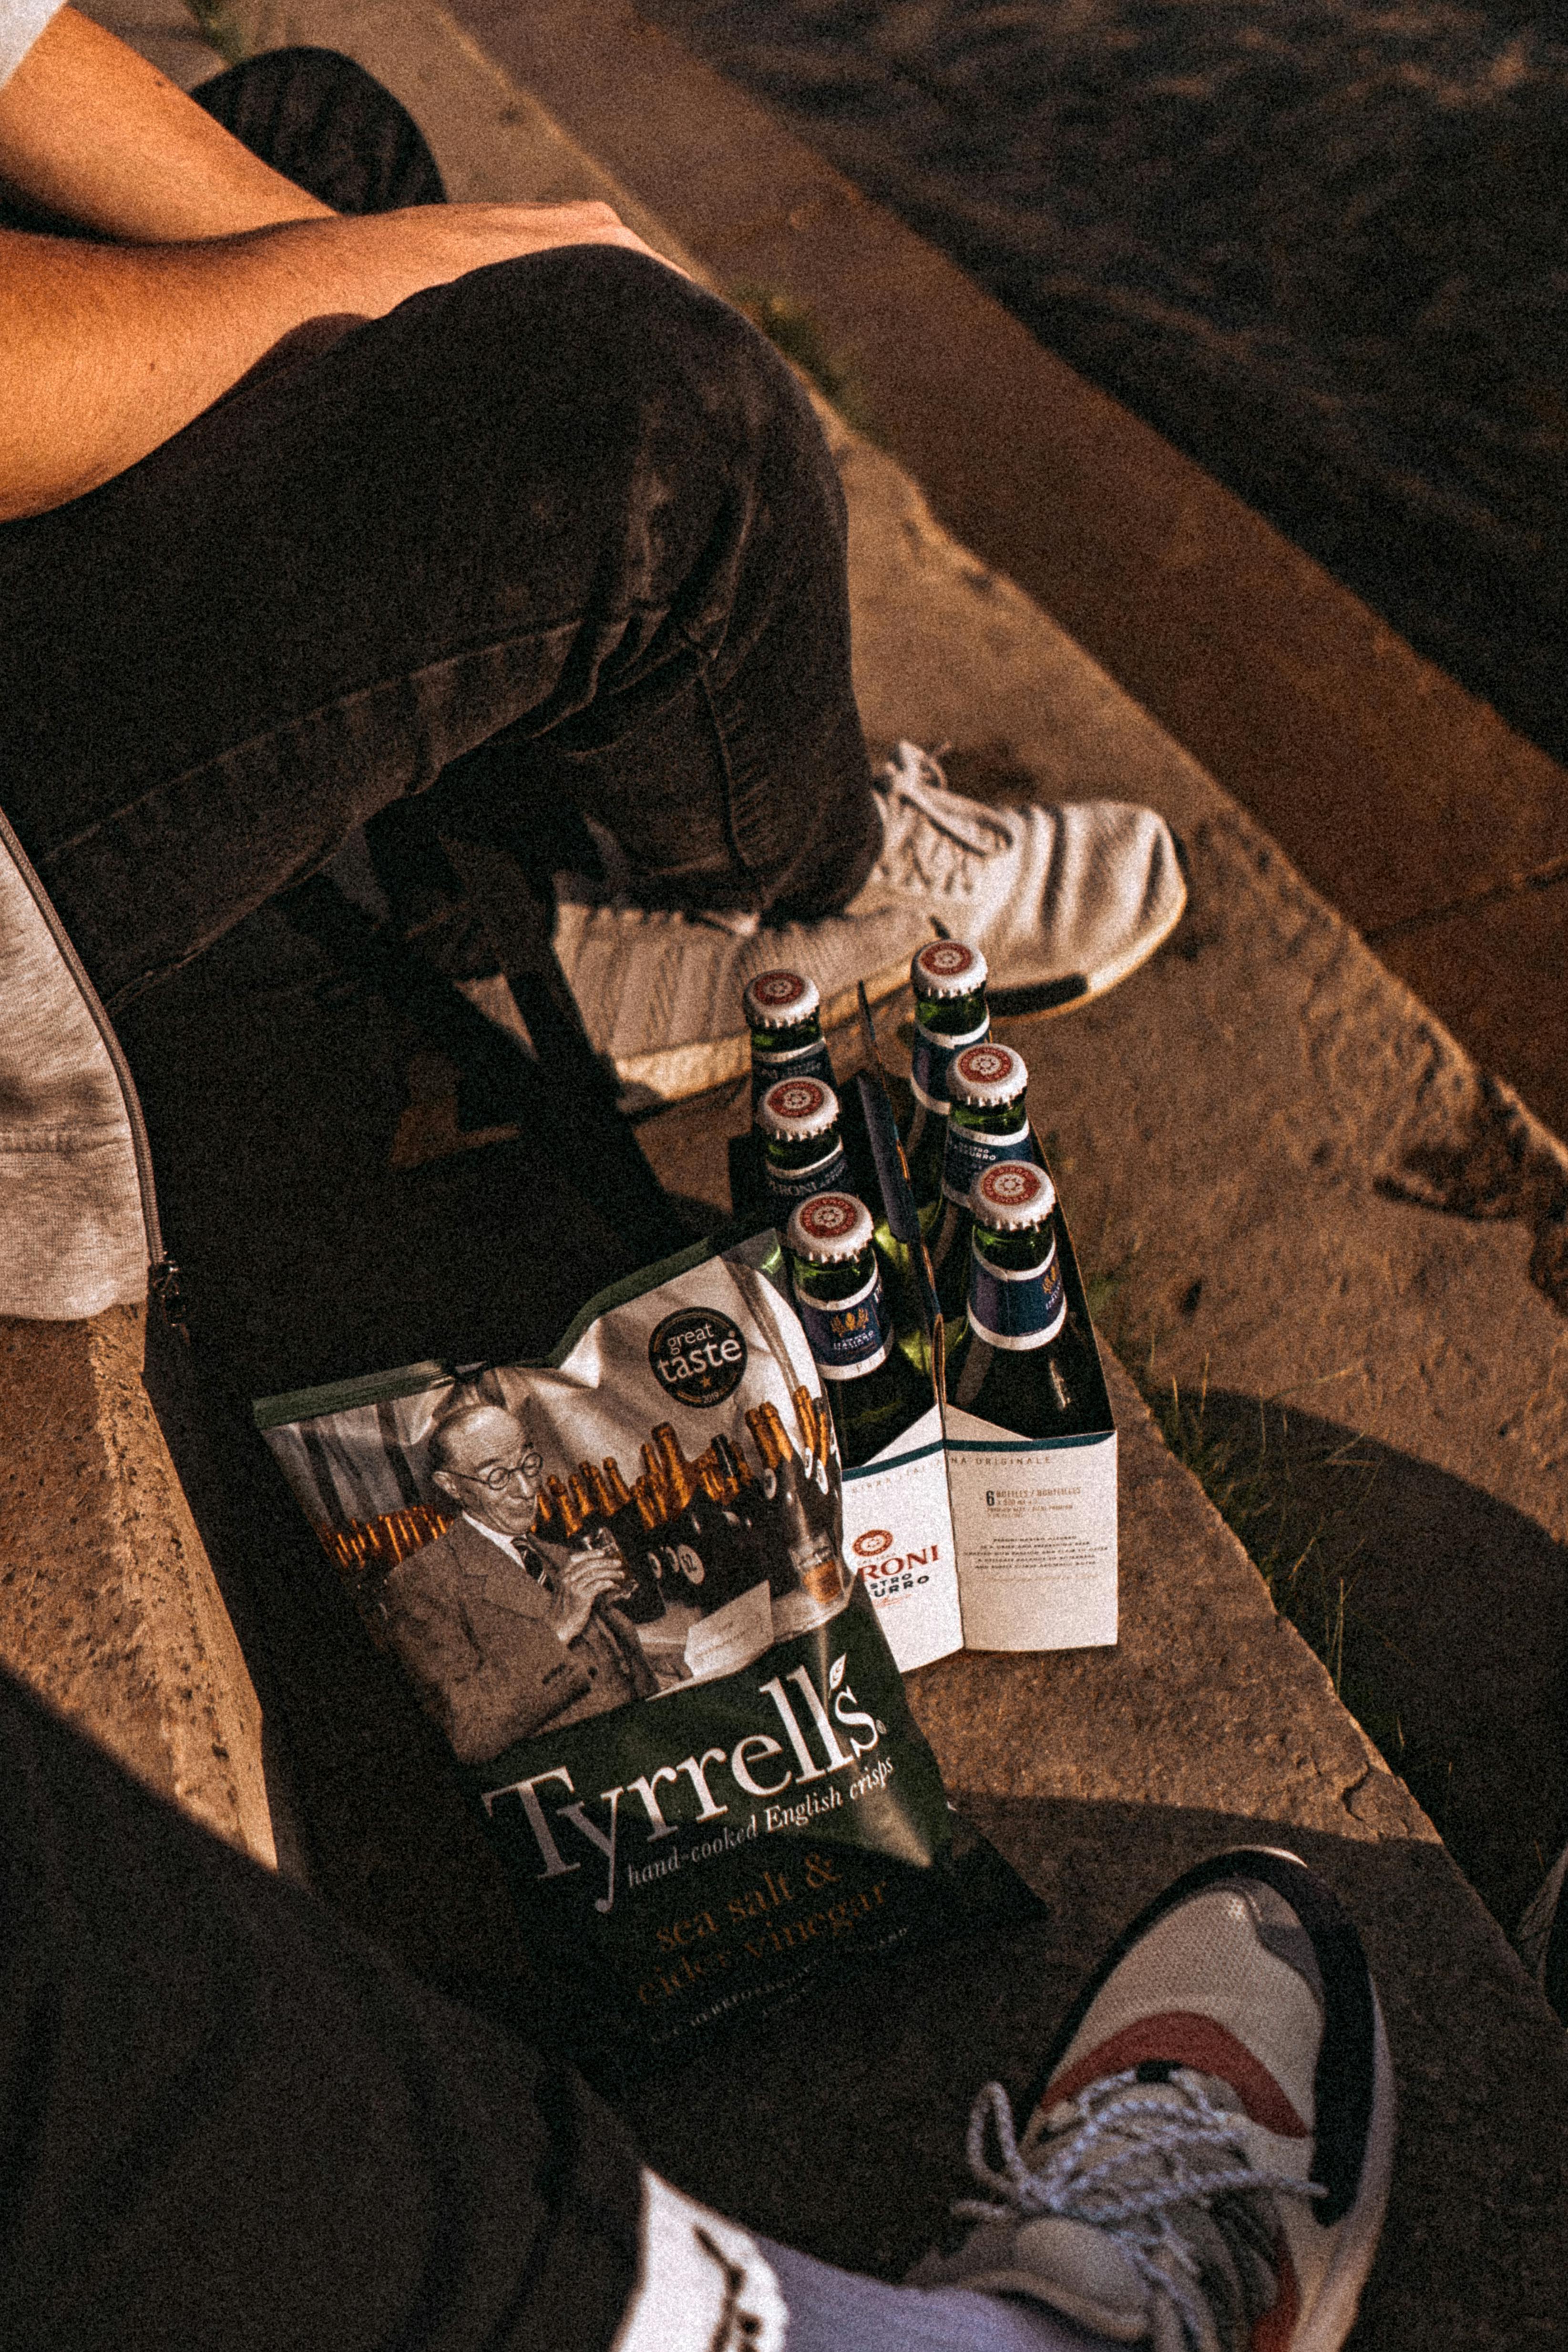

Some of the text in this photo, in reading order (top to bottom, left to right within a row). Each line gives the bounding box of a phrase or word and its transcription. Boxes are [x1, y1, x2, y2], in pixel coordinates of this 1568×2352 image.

[667, 1322, 715, 1356] great
[658, 1339, 743, 1383] taste
[702, 1391, 720, 1404] 2019
[975, 1456, 1052, 1467] ORIGINALE
[986, 1490, 995, 1506] 6
[871, 1573, 912, 1589] STRO
[873, 1575, 930, 1597] URRO
[626, 1755, 894, 1888] hand-cooked English crisps
[656, 1851, 842, 1952] sea salt &
[743, 1880, 889, 1960] vinegar
